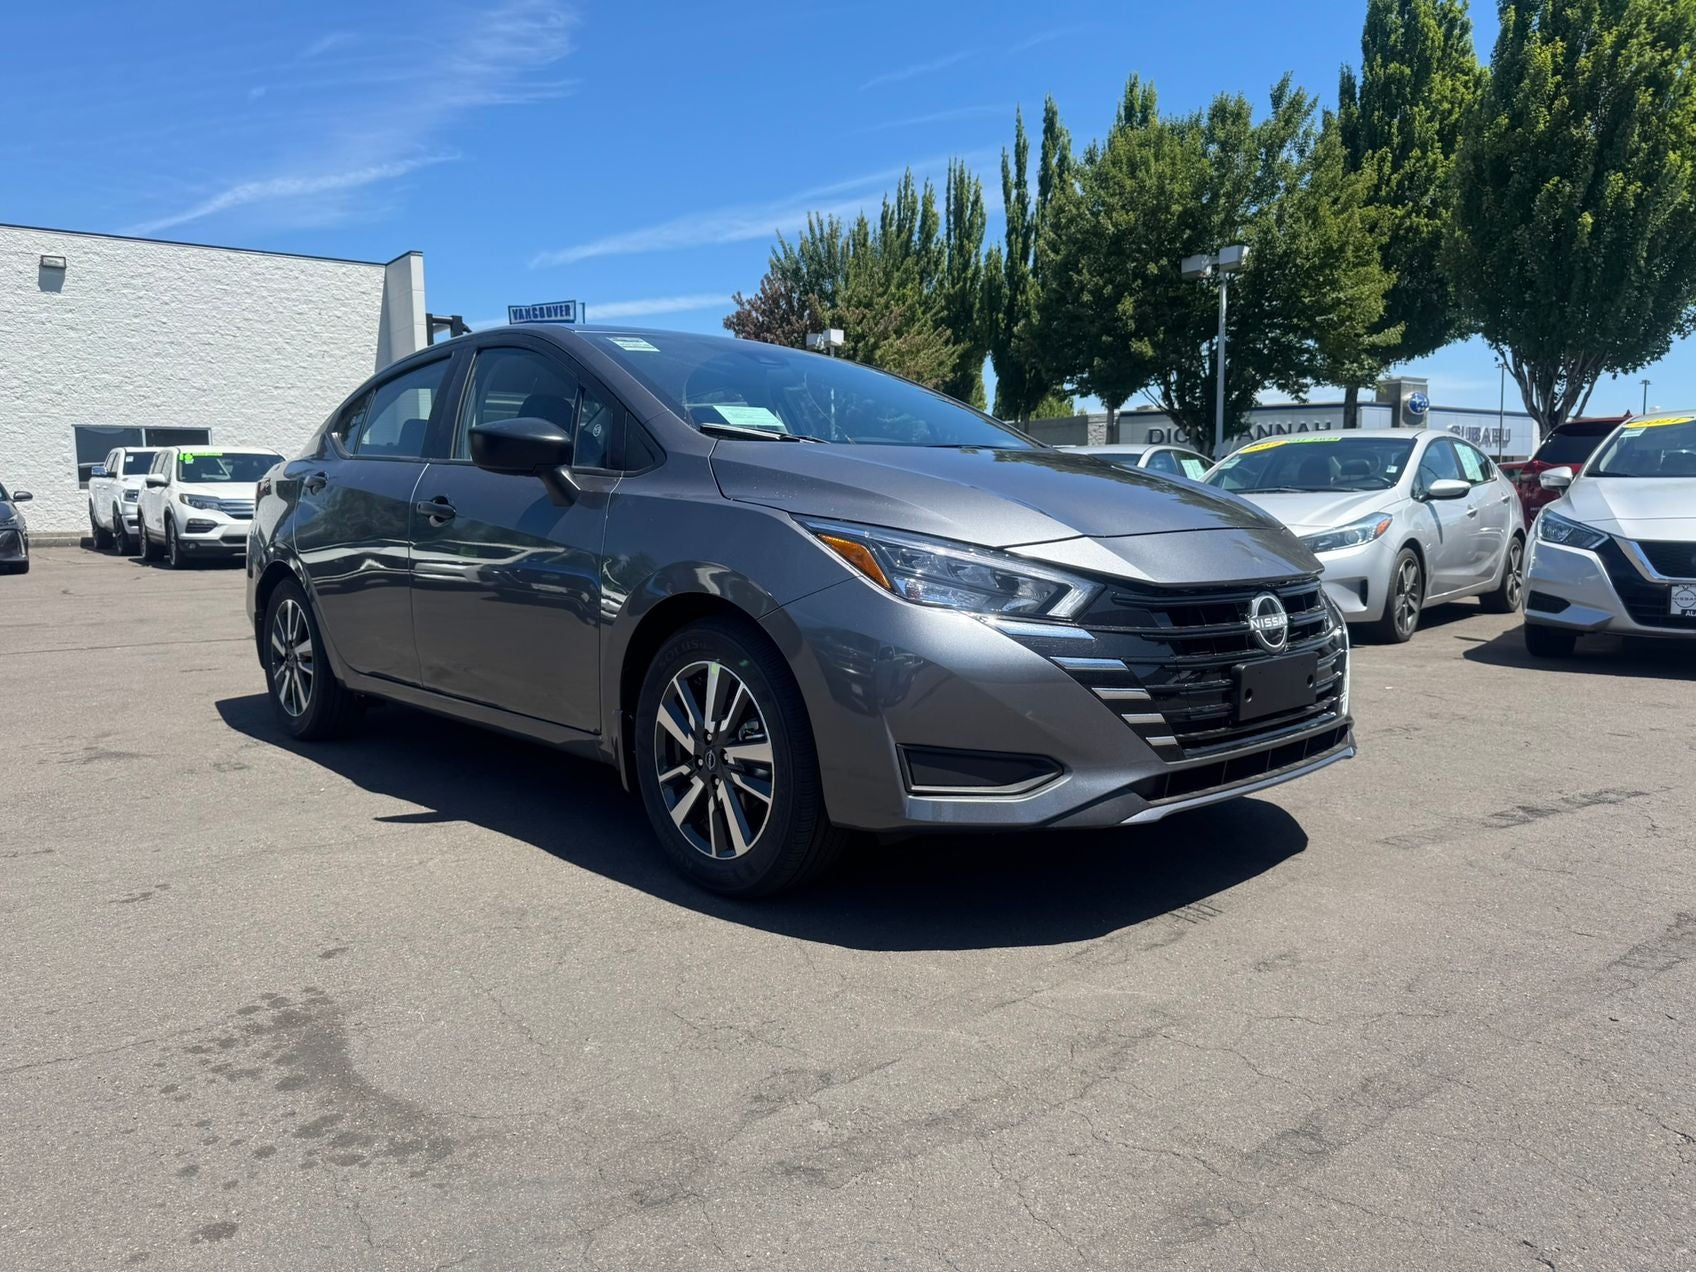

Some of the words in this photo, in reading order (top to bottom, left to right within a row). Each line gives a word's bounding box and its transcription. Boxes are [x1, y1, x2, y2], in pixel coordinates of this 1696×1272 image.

[512, 304, 571, 321] VANCOUVER
[1147, 428, 1191, 445] DIC
[1235, 421, 1332, 441] ANNAH
[1448, 425, 1511, 444] SUBARU
[1250, 616, 1287, 629] NISSAN
